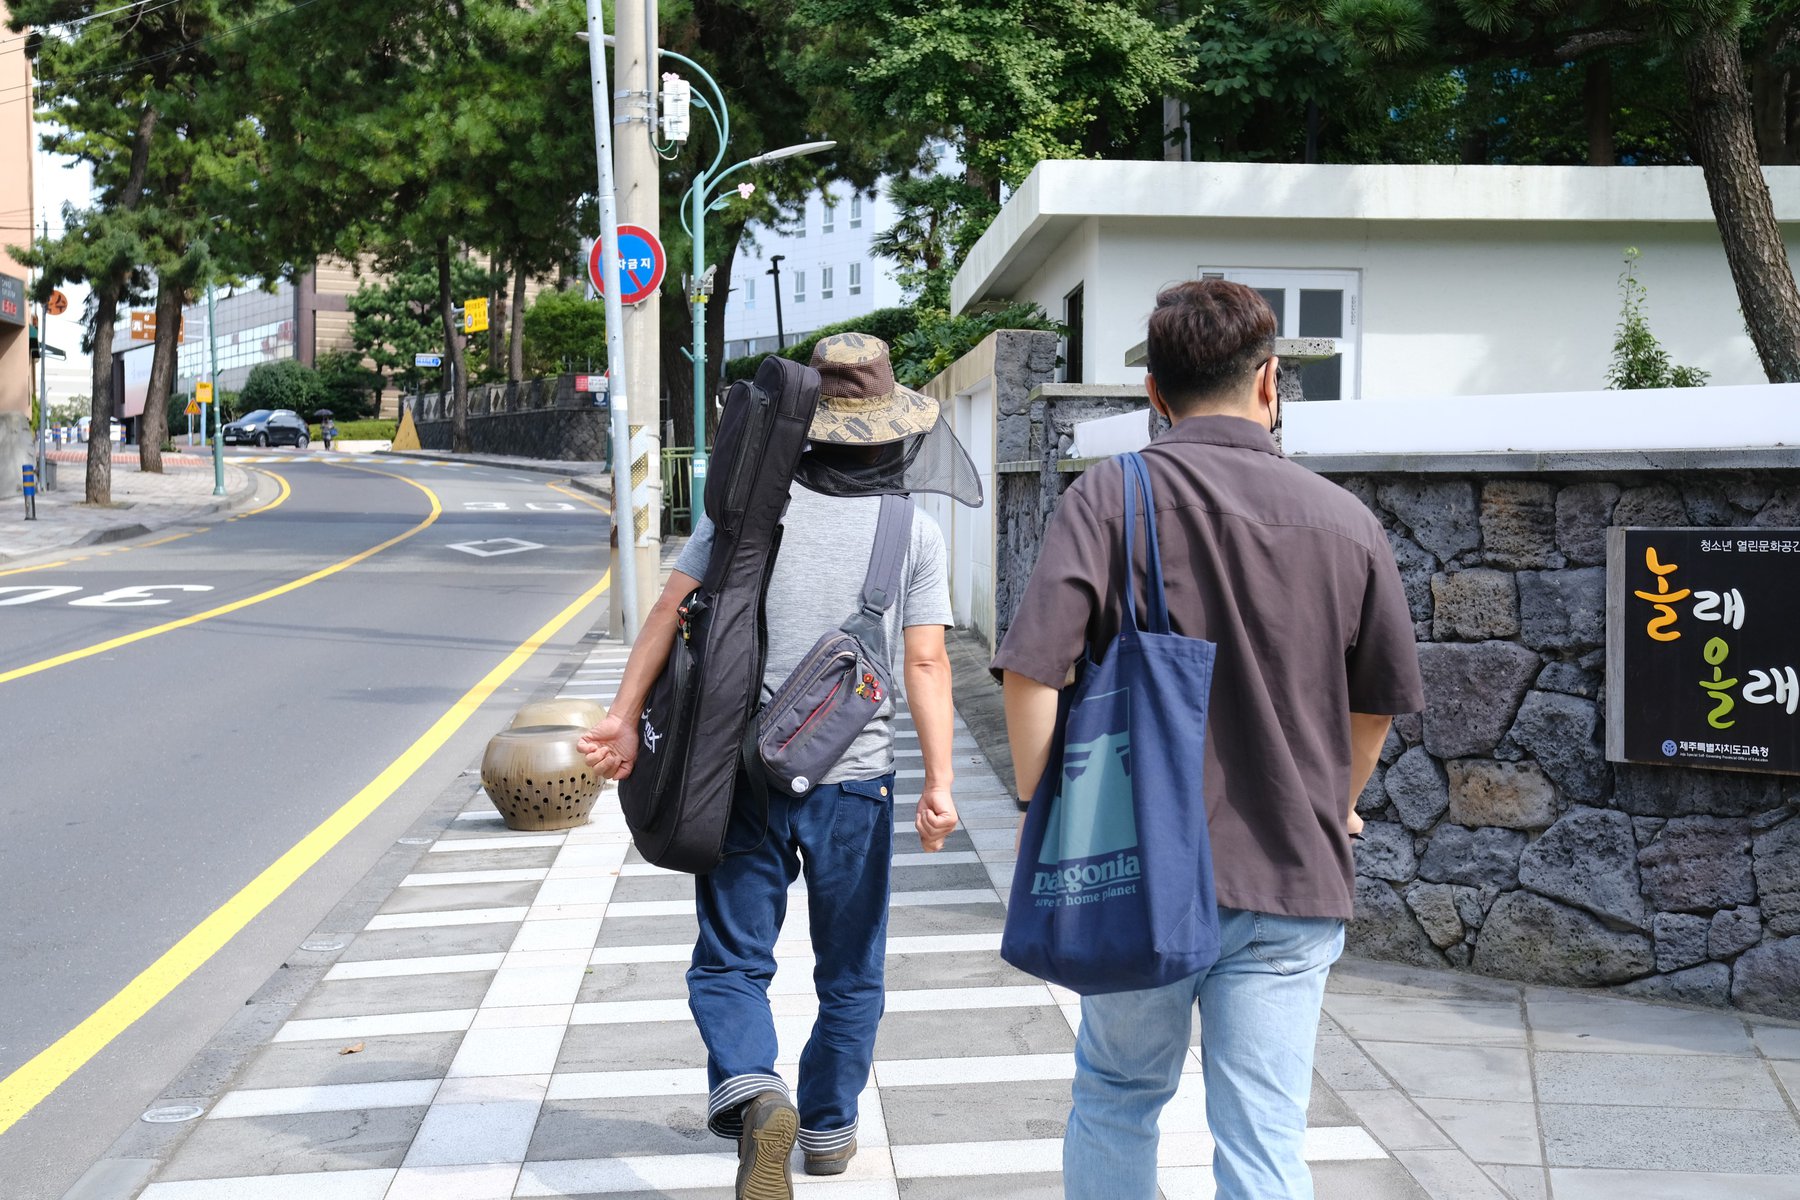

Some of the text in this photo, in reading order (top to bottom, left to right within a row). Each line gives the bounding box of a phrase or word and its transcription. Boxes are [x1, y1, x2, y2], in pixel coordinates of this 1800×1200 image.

[618, 258, 651, 270] 차금지
[463, 501, 576, 511] 30
[1700, 540, 1732, 552] 청소년
[1634, 547, 1745, 642] 놀래
[1699, 636, 1800, 729] 올래
[1680, 741, 1769, 758] 제주특별자치도교육청
[1065, 893, 1100, 906] home
[1101, 884, 1137, 901] planet
